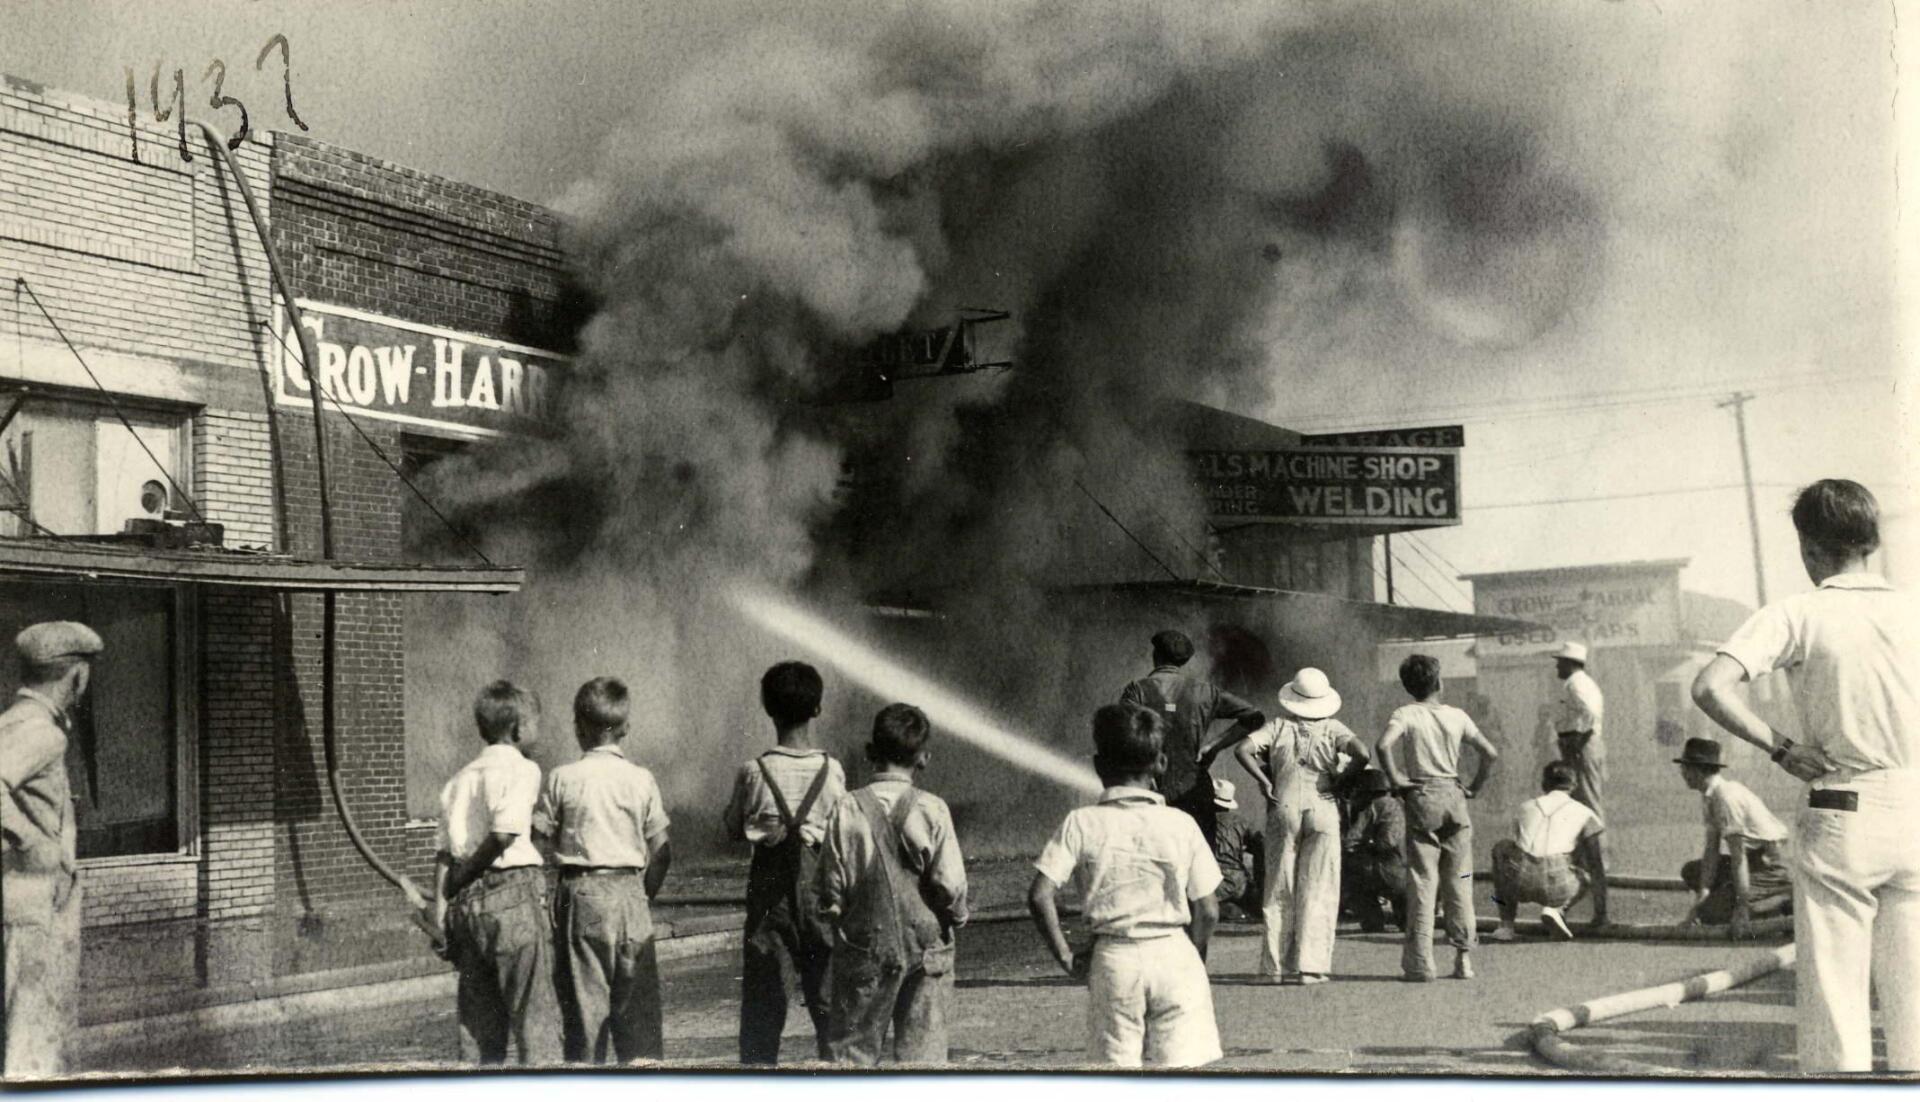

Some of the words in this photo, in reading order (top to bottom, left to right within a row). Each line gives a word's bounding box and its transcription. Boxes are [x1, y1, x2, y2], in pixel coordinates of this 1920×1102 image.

[285, 315, 556, 421] CROW-HARR
[1249, 454, 1359, 480] MACHINE
[1363, 456, 1441, 481] SHOP
[1287, 485, 1448, 517] WELDING
